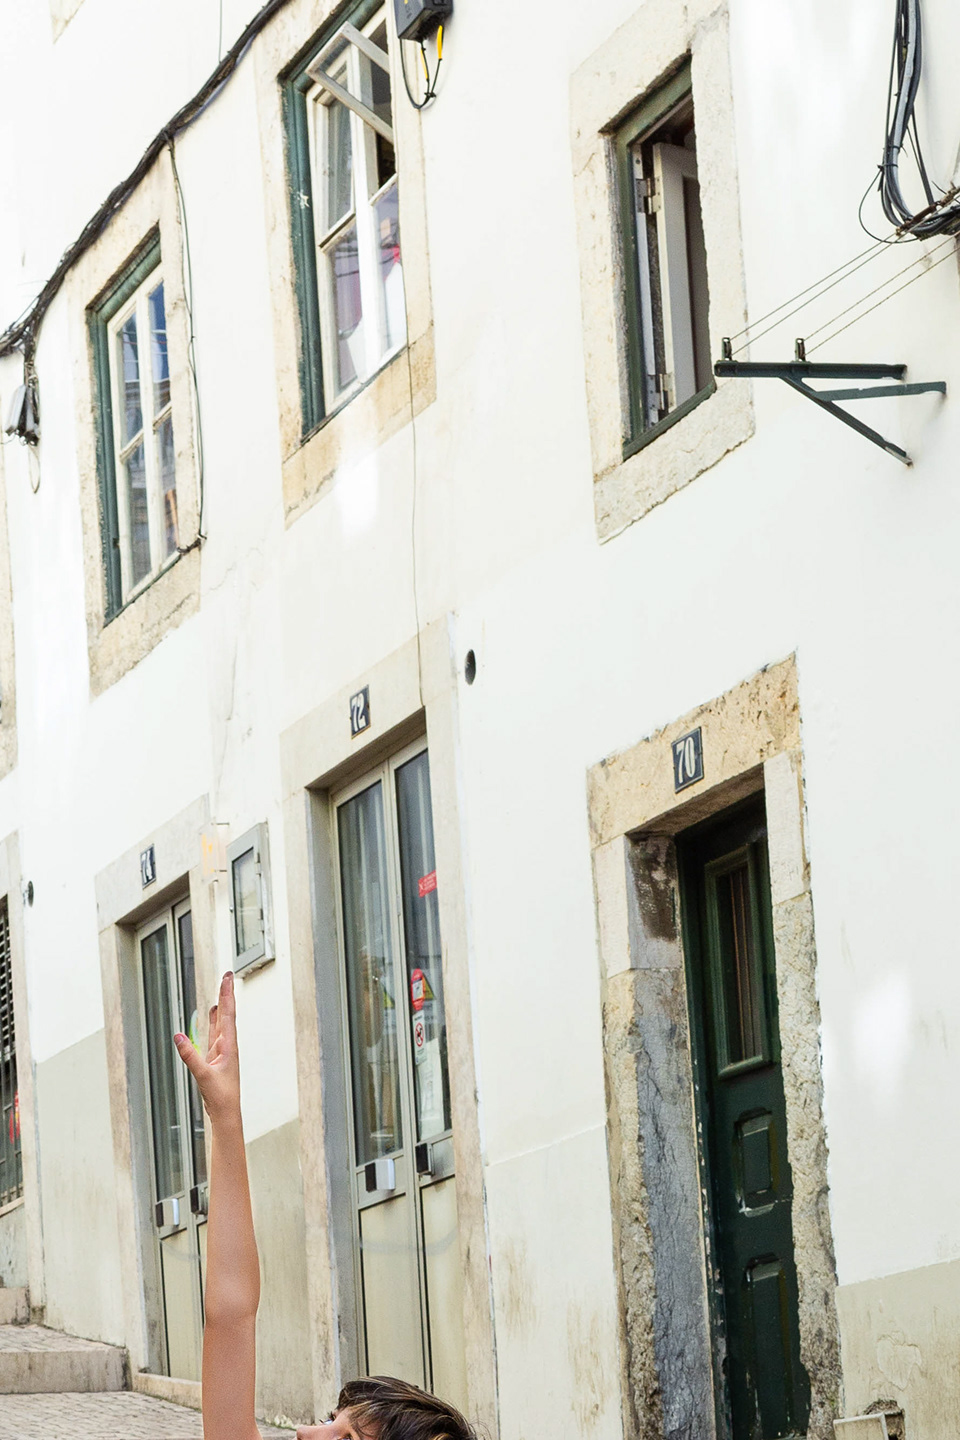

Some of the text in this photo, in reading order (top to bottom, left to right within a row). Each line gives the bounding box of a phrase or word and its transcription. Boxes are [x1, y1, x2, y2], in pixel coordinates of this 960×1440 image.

[351, 692, 367, 732] 72
[676, 736, 696, 784] 70
[141, 850, 154, 884] 74
